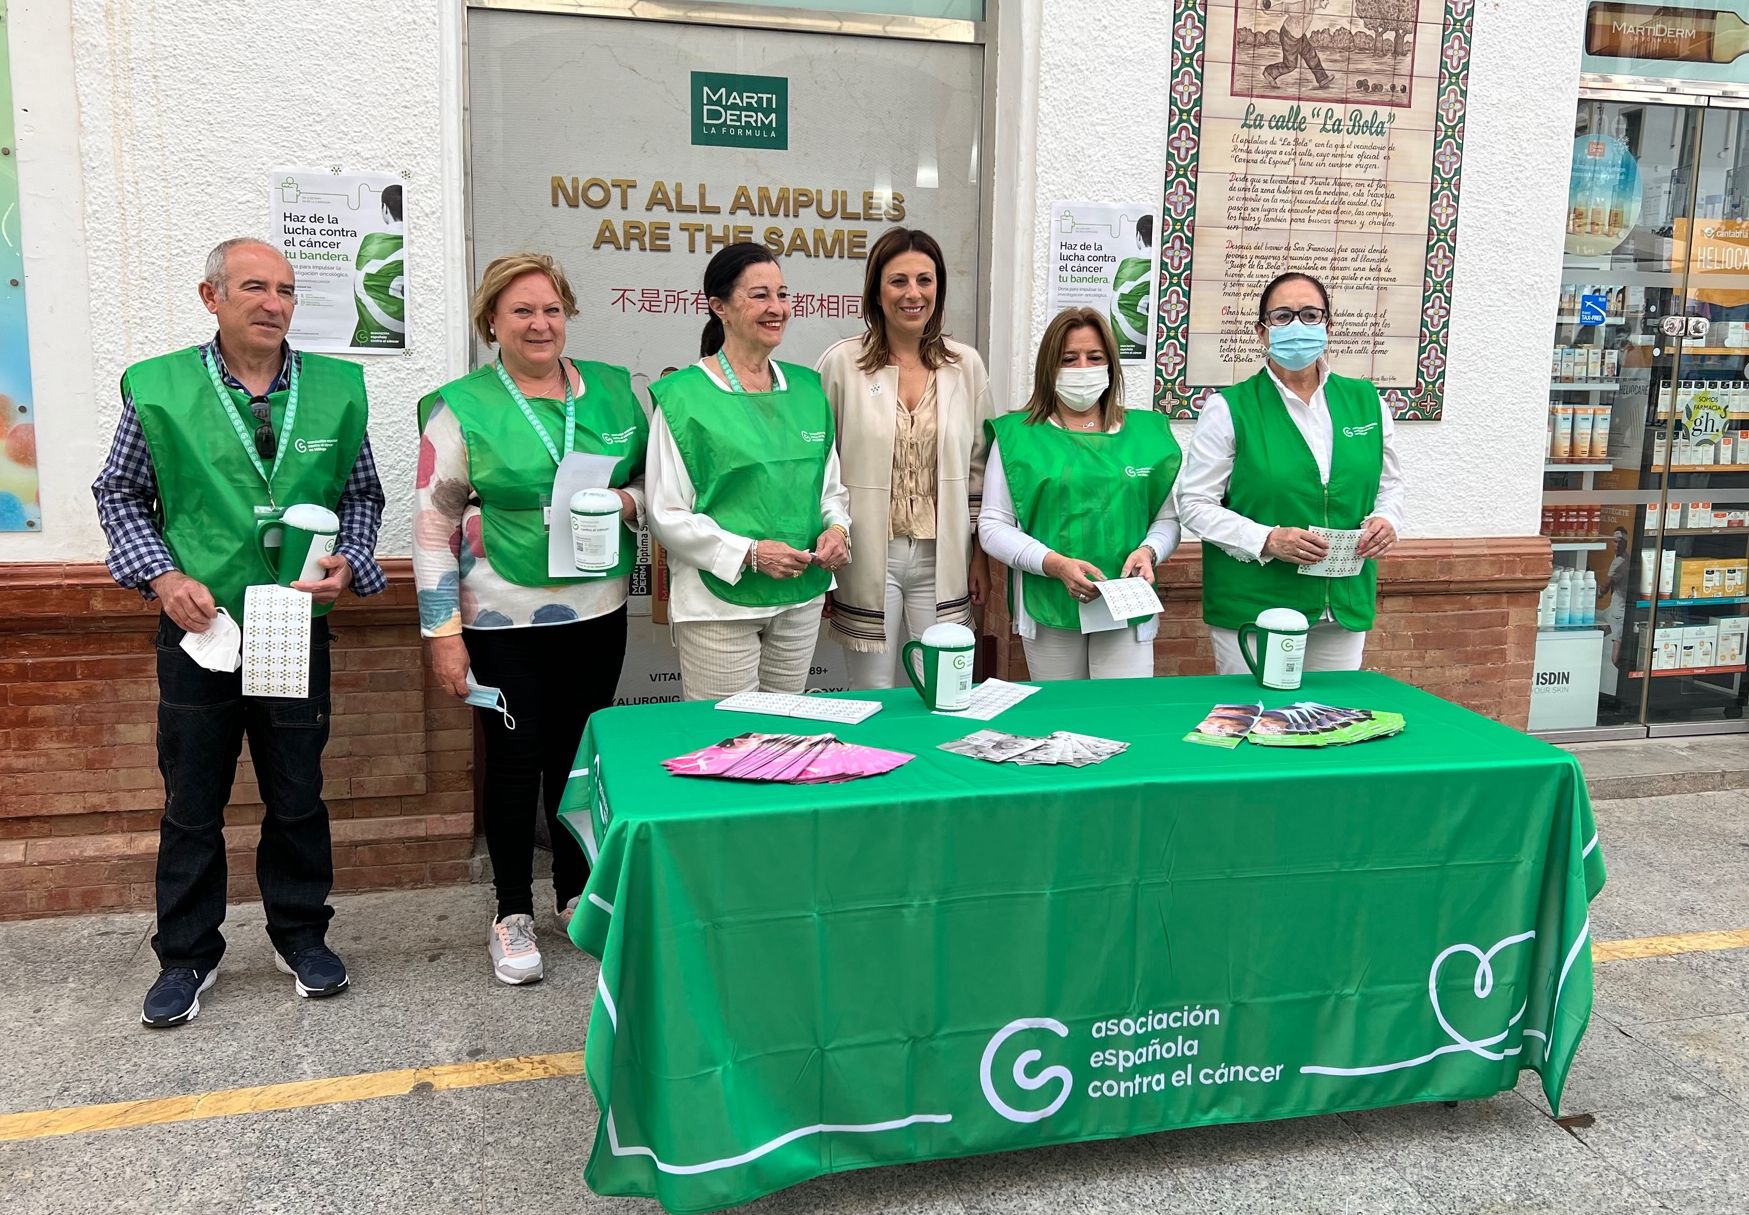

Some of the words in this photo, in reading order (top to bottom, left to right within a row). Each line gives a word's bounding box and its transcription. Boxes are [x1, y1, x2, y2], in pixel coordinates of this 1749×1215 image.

[703, 86, 776, 109] MARTI
[703, 105, 776, 128] DERM
[1241, 103, 1264, 129] La
[1268, 104, 1307, 132] calle
[703, 126, 717, 134] LA
[722, 127, 776, 138] FORMULA
[551, 176, 637, 210] NOT
[645, 180, 721, 213] ALL
[728, 185, 906, 222] AMPULES
[283, 212, 305, 223] Haz
[309, 213, 324, 224] de
[327, 214, 338, 224] la
[283, 224, 316, 236] lucha
[320, 228, 357, 238] contra
[593, 218, 671, 252] ARE
[679, 222, 754, 254] THE
[763, 226, 868, 259] SAME
[284, 237, 294, 247] el
[299, 237, 341, 249] cáncer
[1060, 242, 1078, 251] Haz
[1080, 242, 1092, 251] de
[1094, 242, 1102, 251] la
[284, 250, 296, 259] tu
[300, 249, 351, 262] bandera.
[1060, 253, 1085, 262] lucha
[1087, 254, 1116, 262] contra
[1059, 264, 1068, 272] el
[1071, 264, 1103, 273] cáncer
[1058, 275, 1068, 283] tu
[1070, 274, 1110, 284] bandera.
[640, 533, 650, 563] Optima
[638, 566, 646, 594] DERM
[1536, 672, 1570, 686] ISDIN
[1092, 1004, 1220, 1038] asociación
[1090, 1036, 1199, 1072] española
[1088, 1072, 1165, 1098] contra
[1171, 1064, 1192, 1086] el
[1199, 1063, 1284, 1085] cáncer
